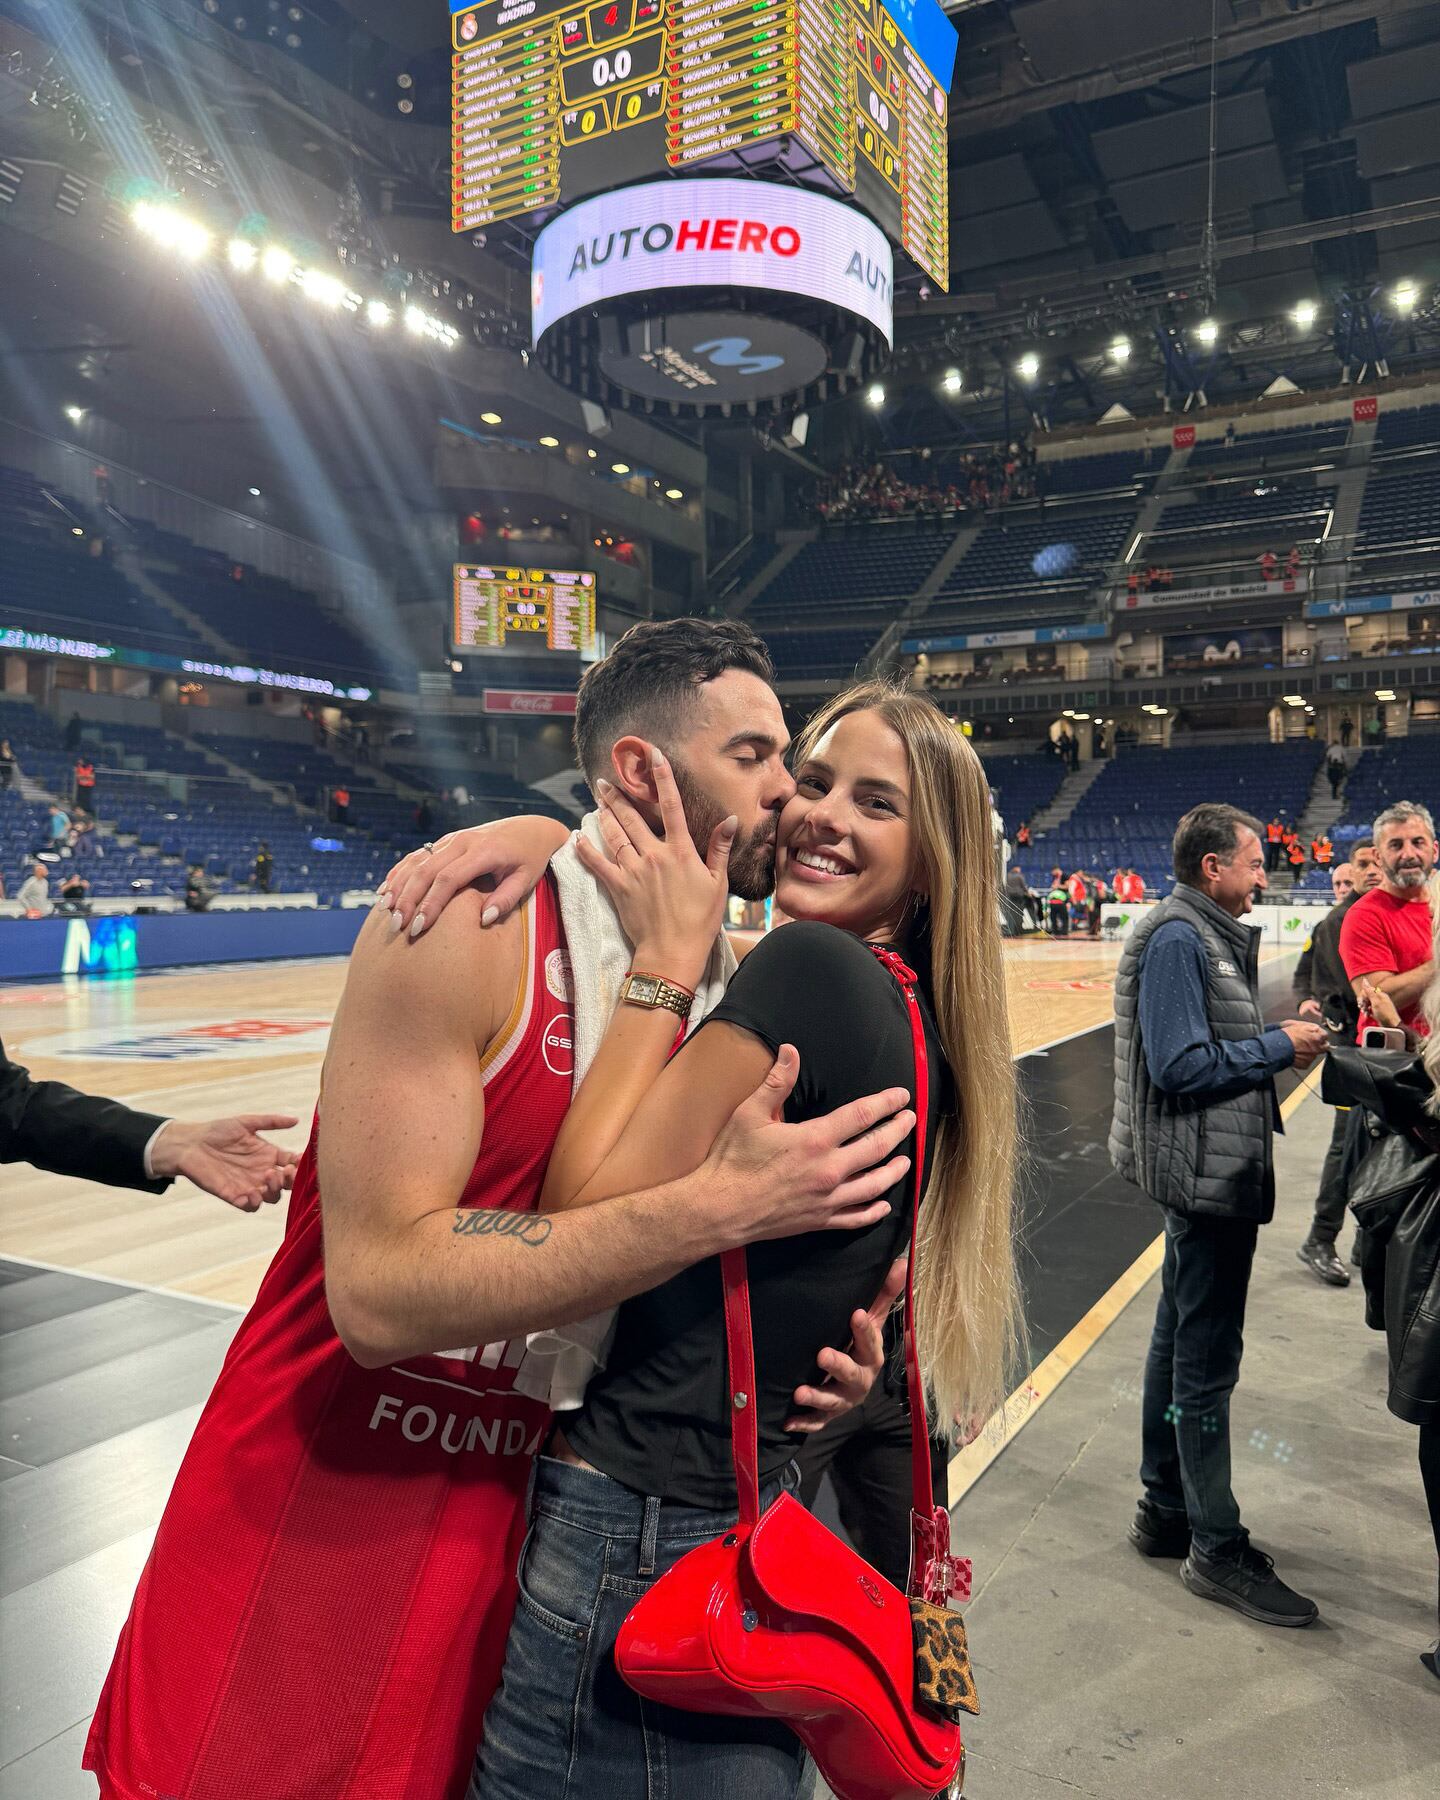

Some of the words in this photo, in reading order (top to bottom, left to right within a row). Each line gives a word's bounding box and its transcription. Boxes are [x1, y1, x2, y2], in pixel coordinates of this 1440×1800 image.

[604, 5, 618, 26] 4
[592, 49, 632, 87] 0.0
[626, 95, 642, 119] 0
[581, 110, 596, 134] 0
[568, 219, 801, 281] AUTOHERO
[1153, 589, 1212, 604] Comunidad
[1213, 588, 1227, 598] de
[1229, 584, 1269, 597] Madrid
[546, 1035, 572, 1049] GS
